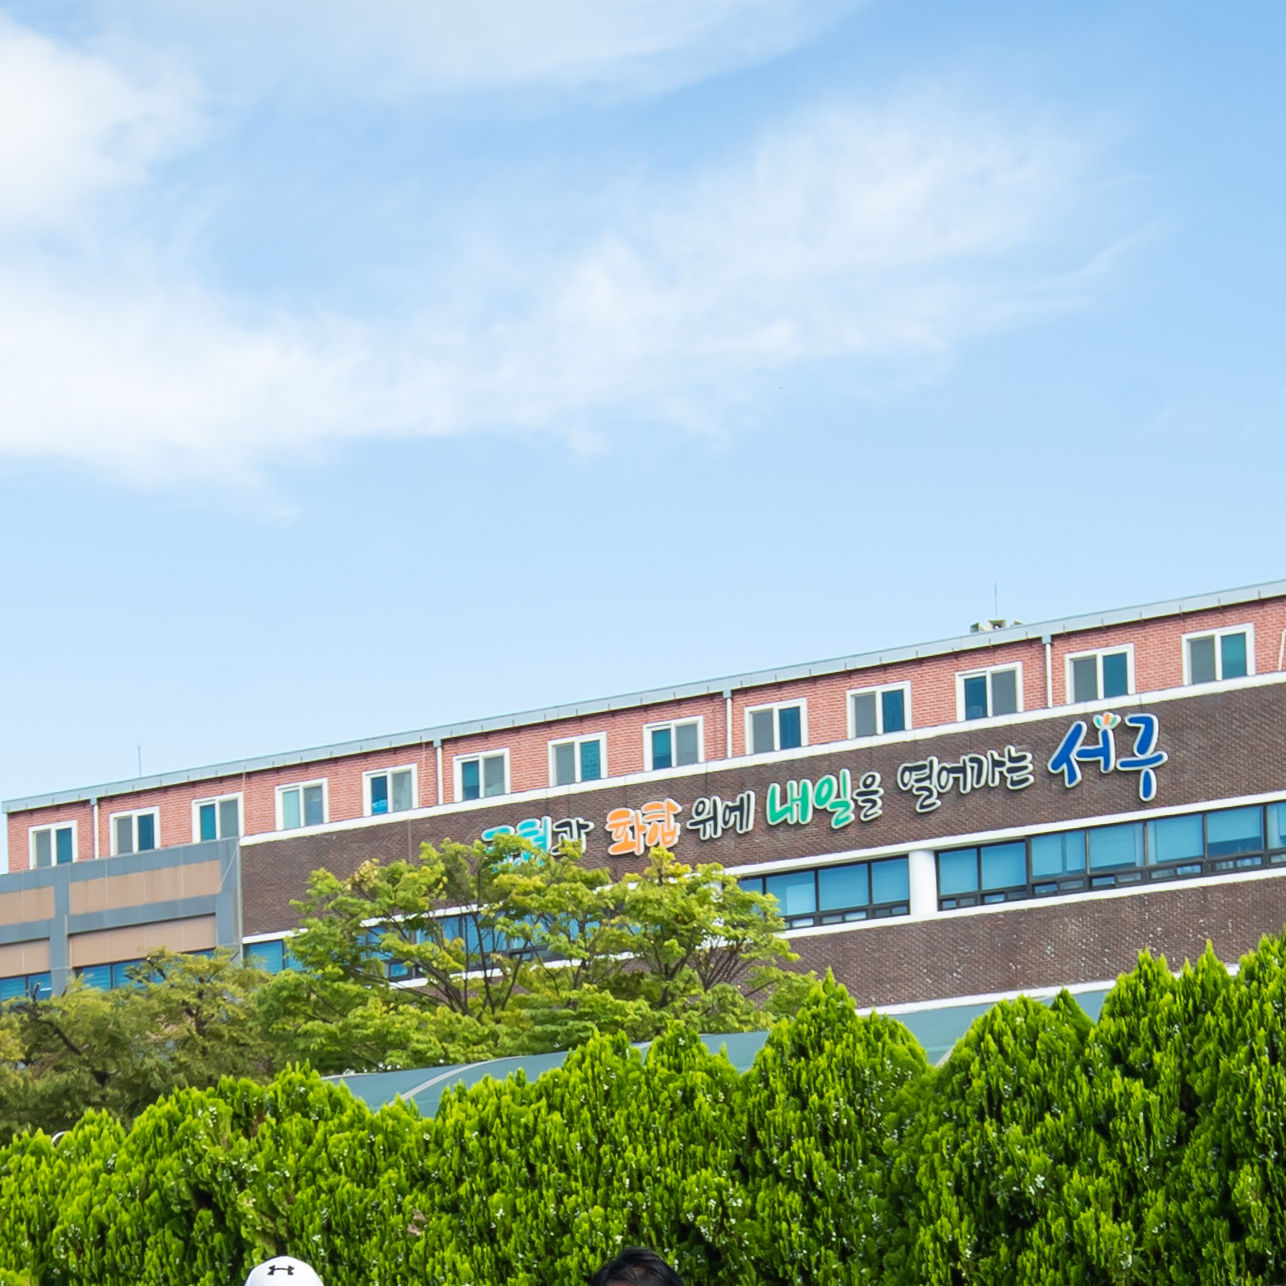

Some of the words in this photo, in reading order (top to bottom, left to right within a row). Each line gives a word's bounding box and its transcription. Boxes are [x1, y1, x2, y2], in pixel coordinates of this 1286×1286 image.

[605, 798, 682, 856] 화합
[687, 790, 756, 840] 위에
[766, 768, 884, 829] 내일을
[897, 745, 1035, 813] 열어가는
[1047, 712, 1168, 801] 서구
